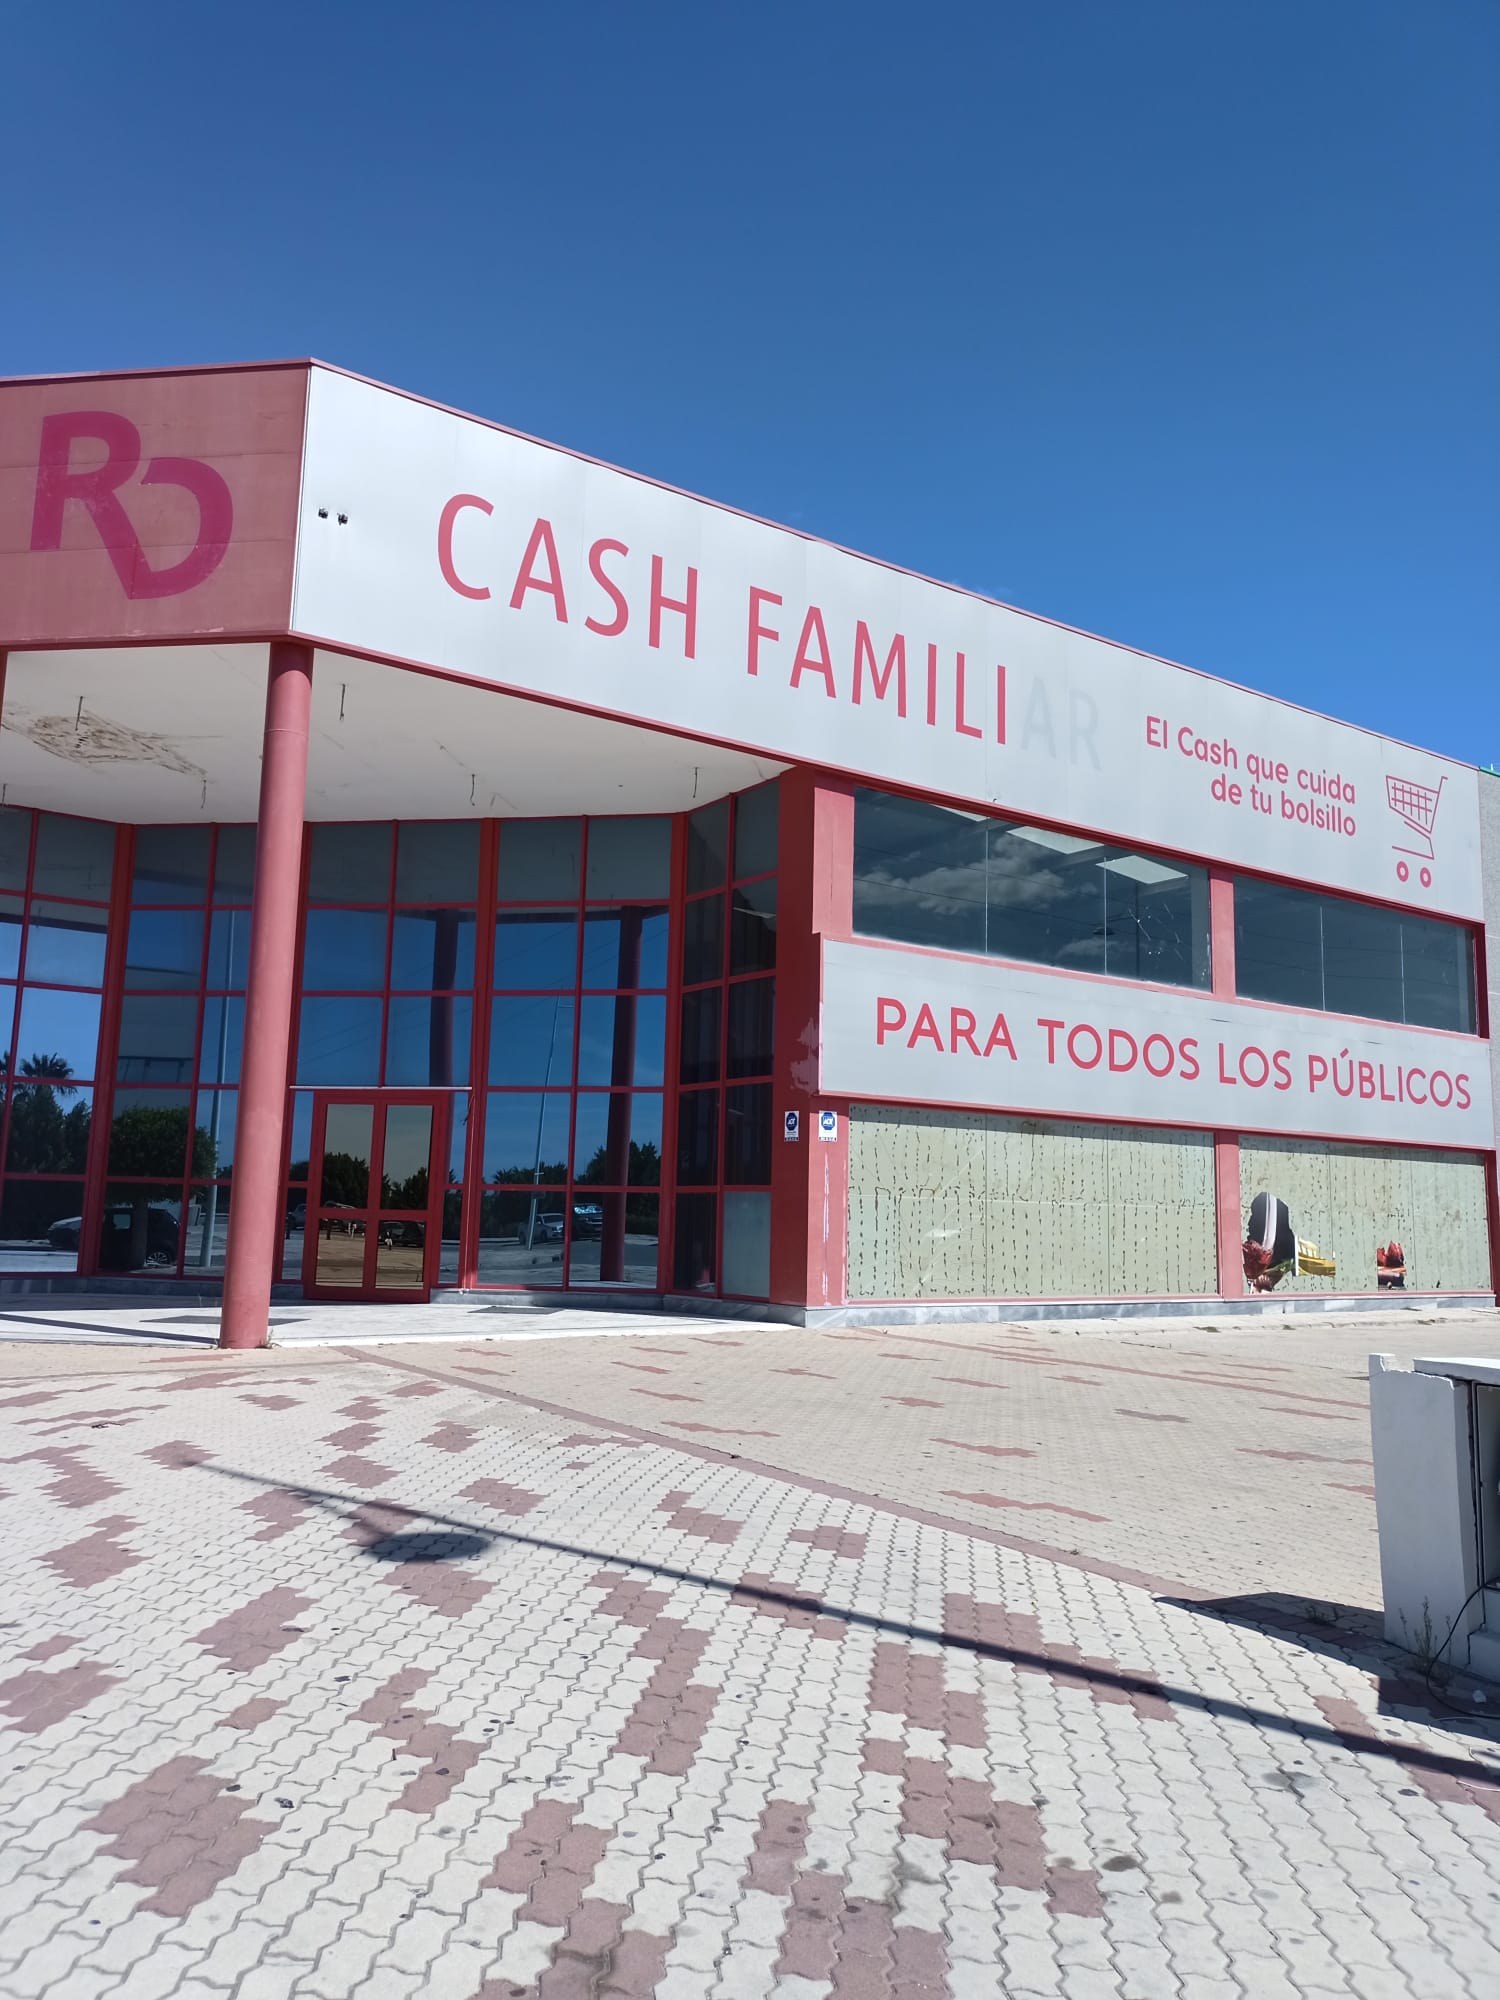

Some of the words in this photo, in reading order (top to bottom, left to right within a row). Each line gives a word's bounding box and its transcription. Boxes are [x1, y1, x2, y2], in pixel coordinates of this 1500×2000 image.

[437, 493, 699, 660] CASH
[1146, 715, 1169, 749] El
[1178, 726, 1238, 769] Cash
[1246, 753, 1289, 784] que
[1297, 769, 1356, 804] cuida
[1211, 773, 1242, 805] de
[1250, 784, 1272, 815] tu
[1281, 790, 1356, 836] bolsillo
[876, 996, 1018, 1061] PARA
[1036, 1018, 1201, 1081] TODOS
[1218, 1042, 1293, 1091] LOS
[1308, 1048, 1471, 1110] PÚBLICOS
